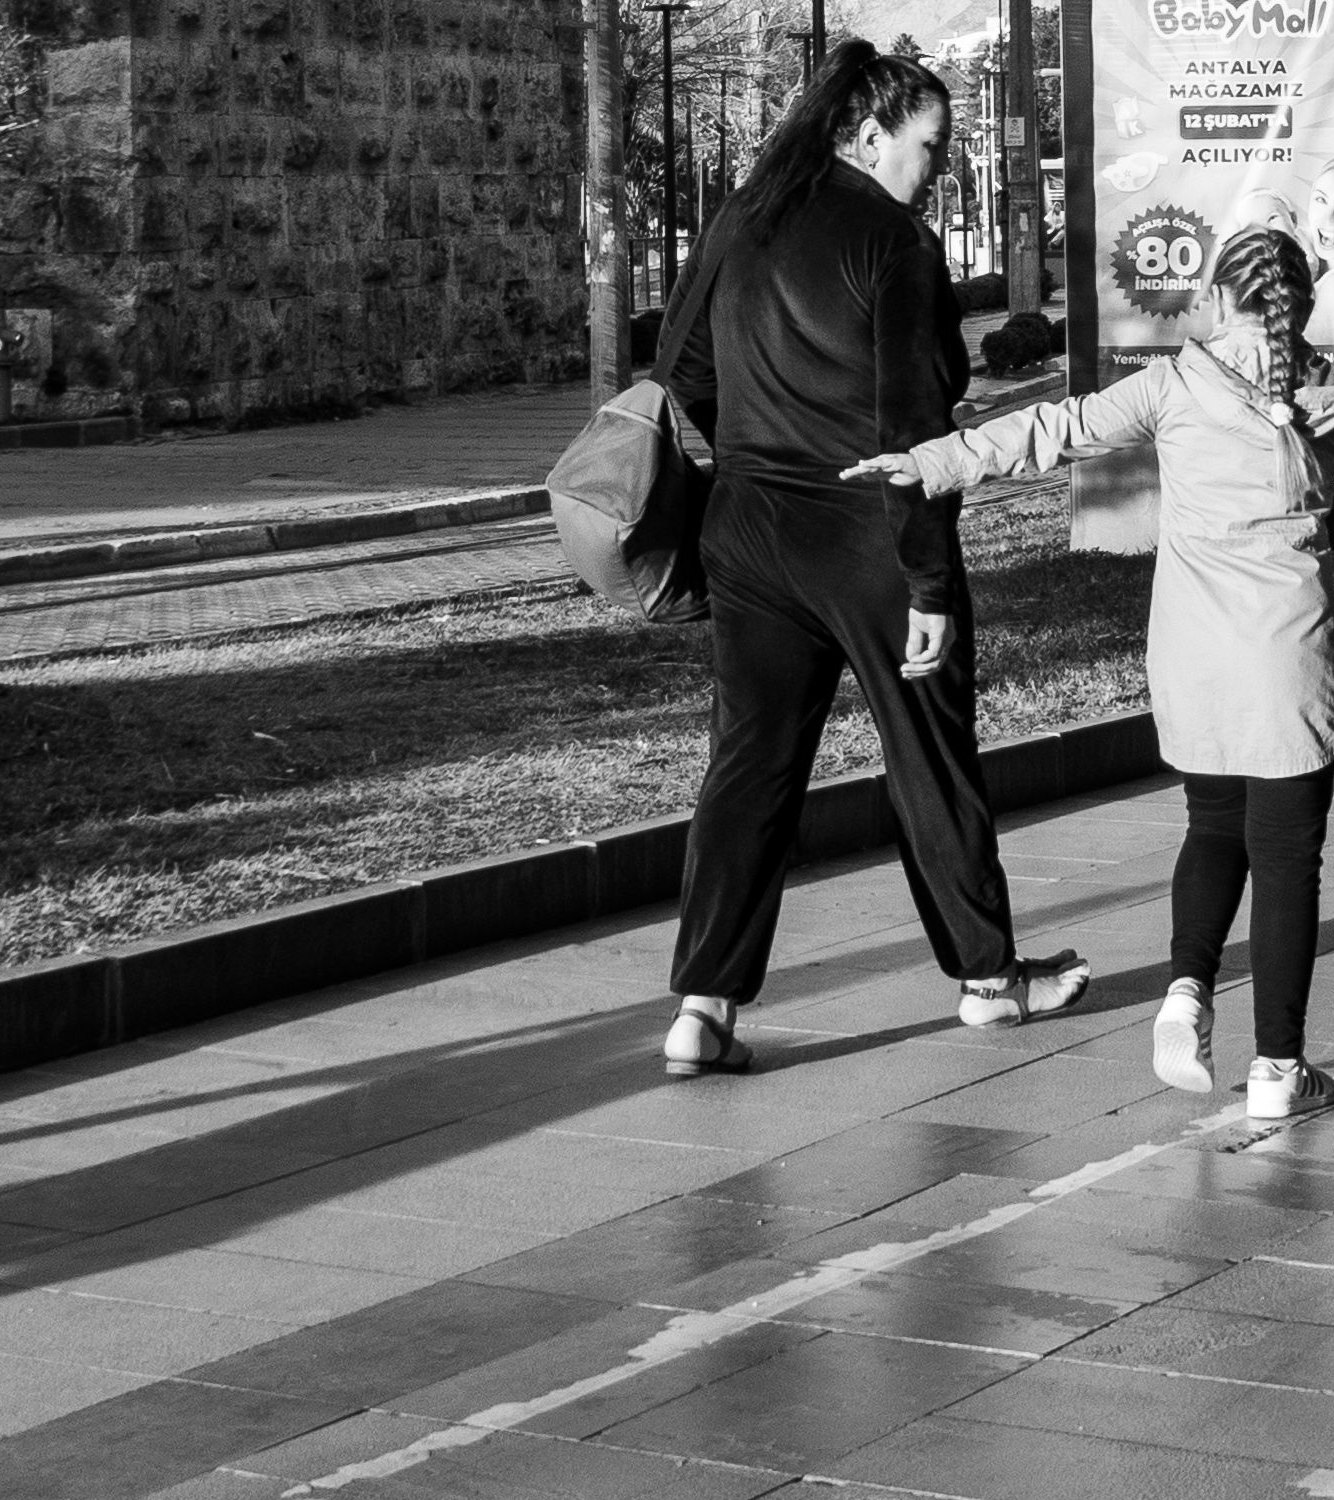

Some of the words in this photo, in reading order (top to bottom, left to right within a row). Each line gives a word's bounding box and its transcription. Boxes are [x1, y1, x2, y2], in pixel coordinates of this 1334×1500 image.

[1185, 60, 1287, 75] ANTALYA
[1169, 79, 1303, 99] MAĞAZAMIZ
[1184, 114, 1202, 129] 12
[1182, 147, 1293, 167] AÇILIYOR!
[1132, 218, 1171, 237] AÇILIŞA
[1172, 217, 1198, 235] ÖZEL
